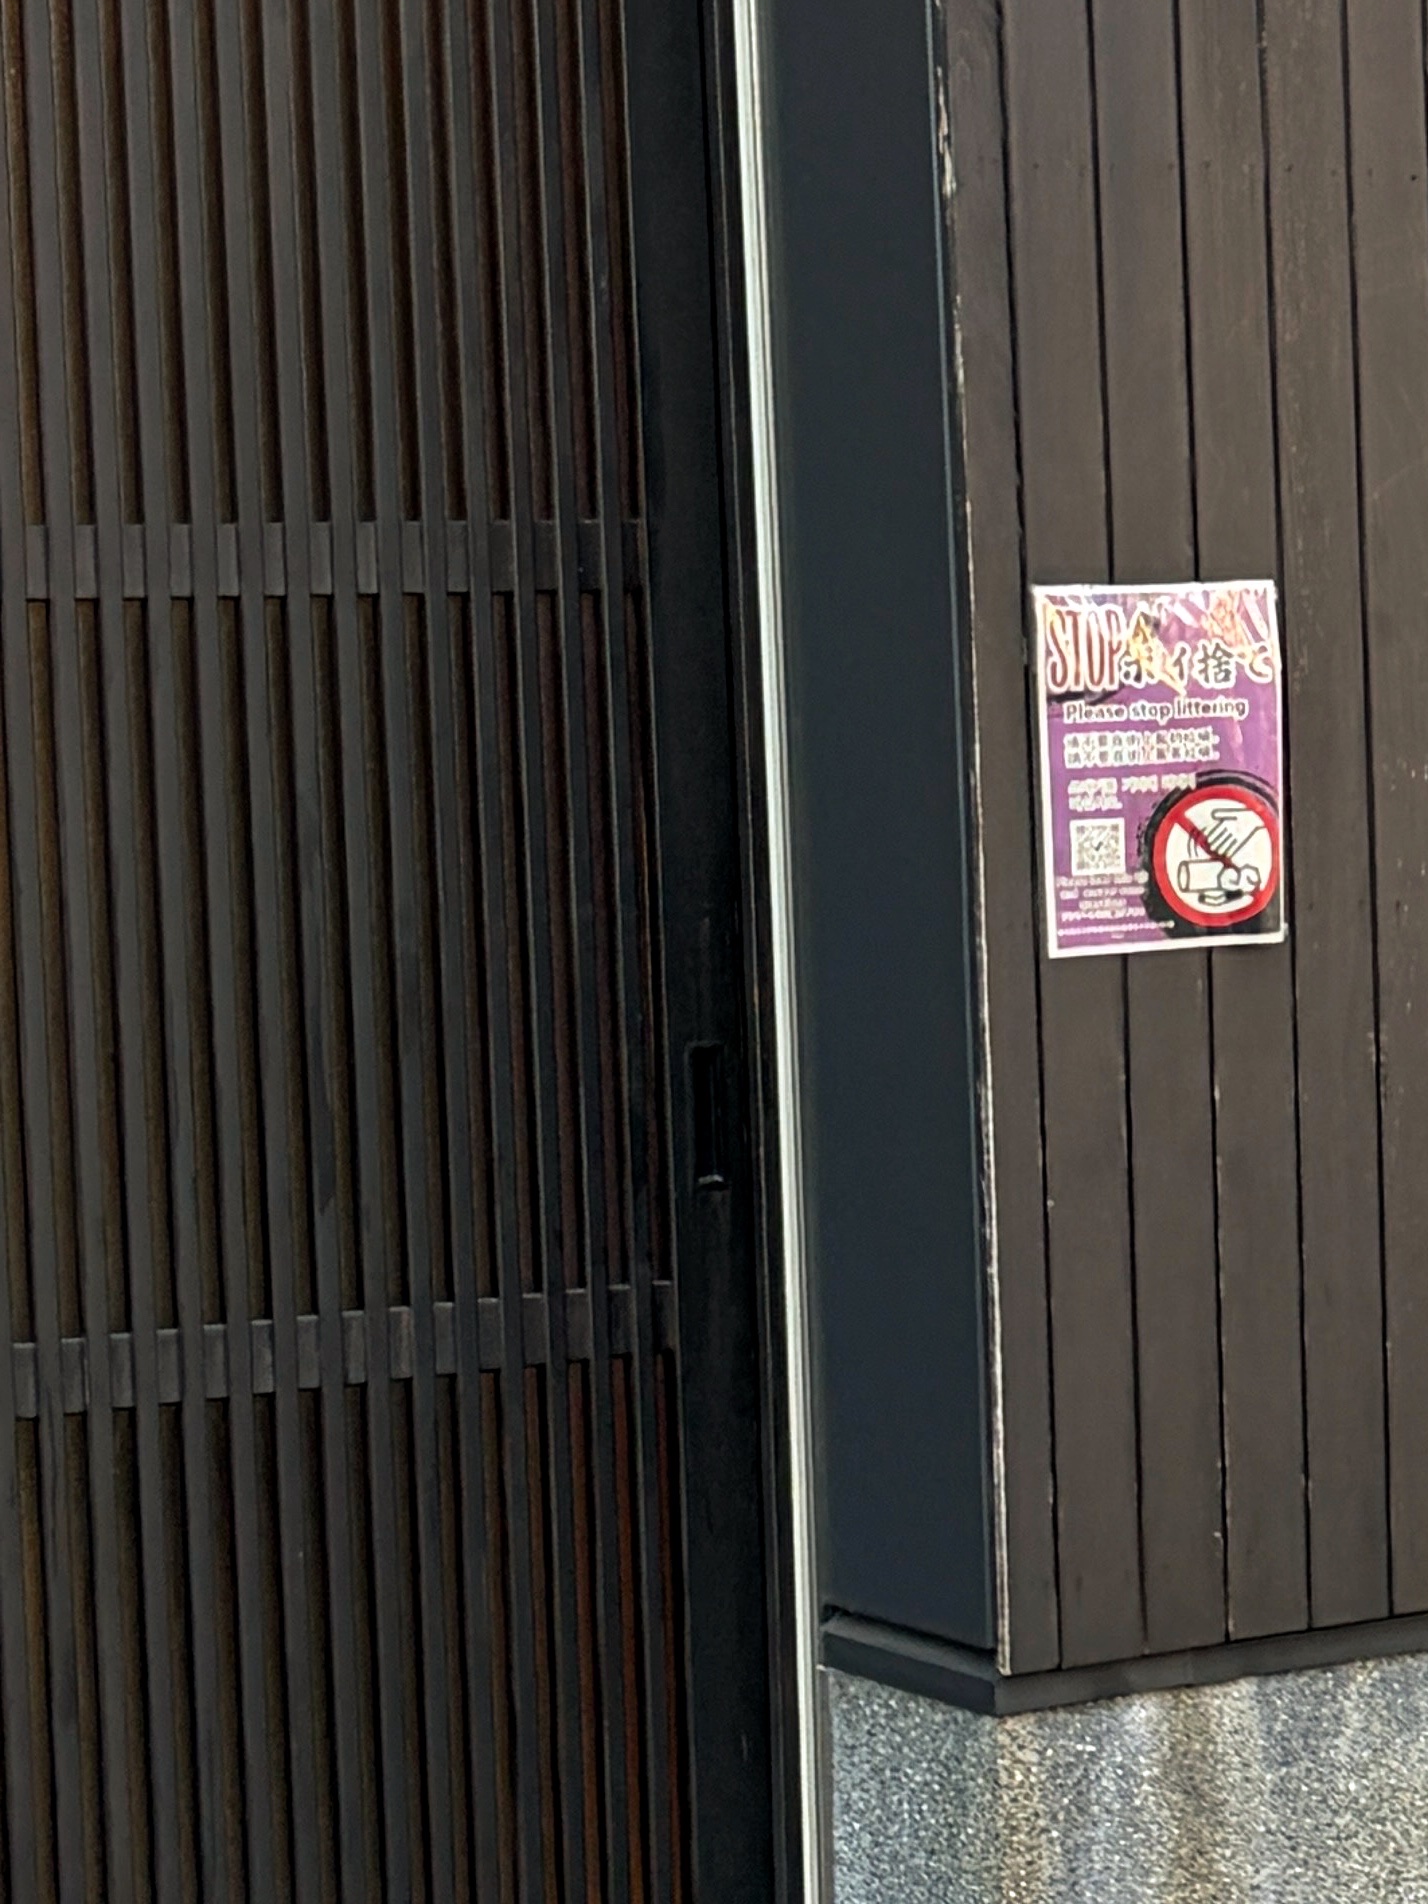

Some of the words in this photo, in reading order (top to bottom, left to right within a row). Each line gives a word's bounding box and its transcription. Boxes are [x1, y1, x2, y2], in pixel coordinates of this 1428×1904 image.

[1064, 702, 1126, 723] Please
[1131, 700, 1171, 724] stop
[1176, 697, 1247, 719] littering
